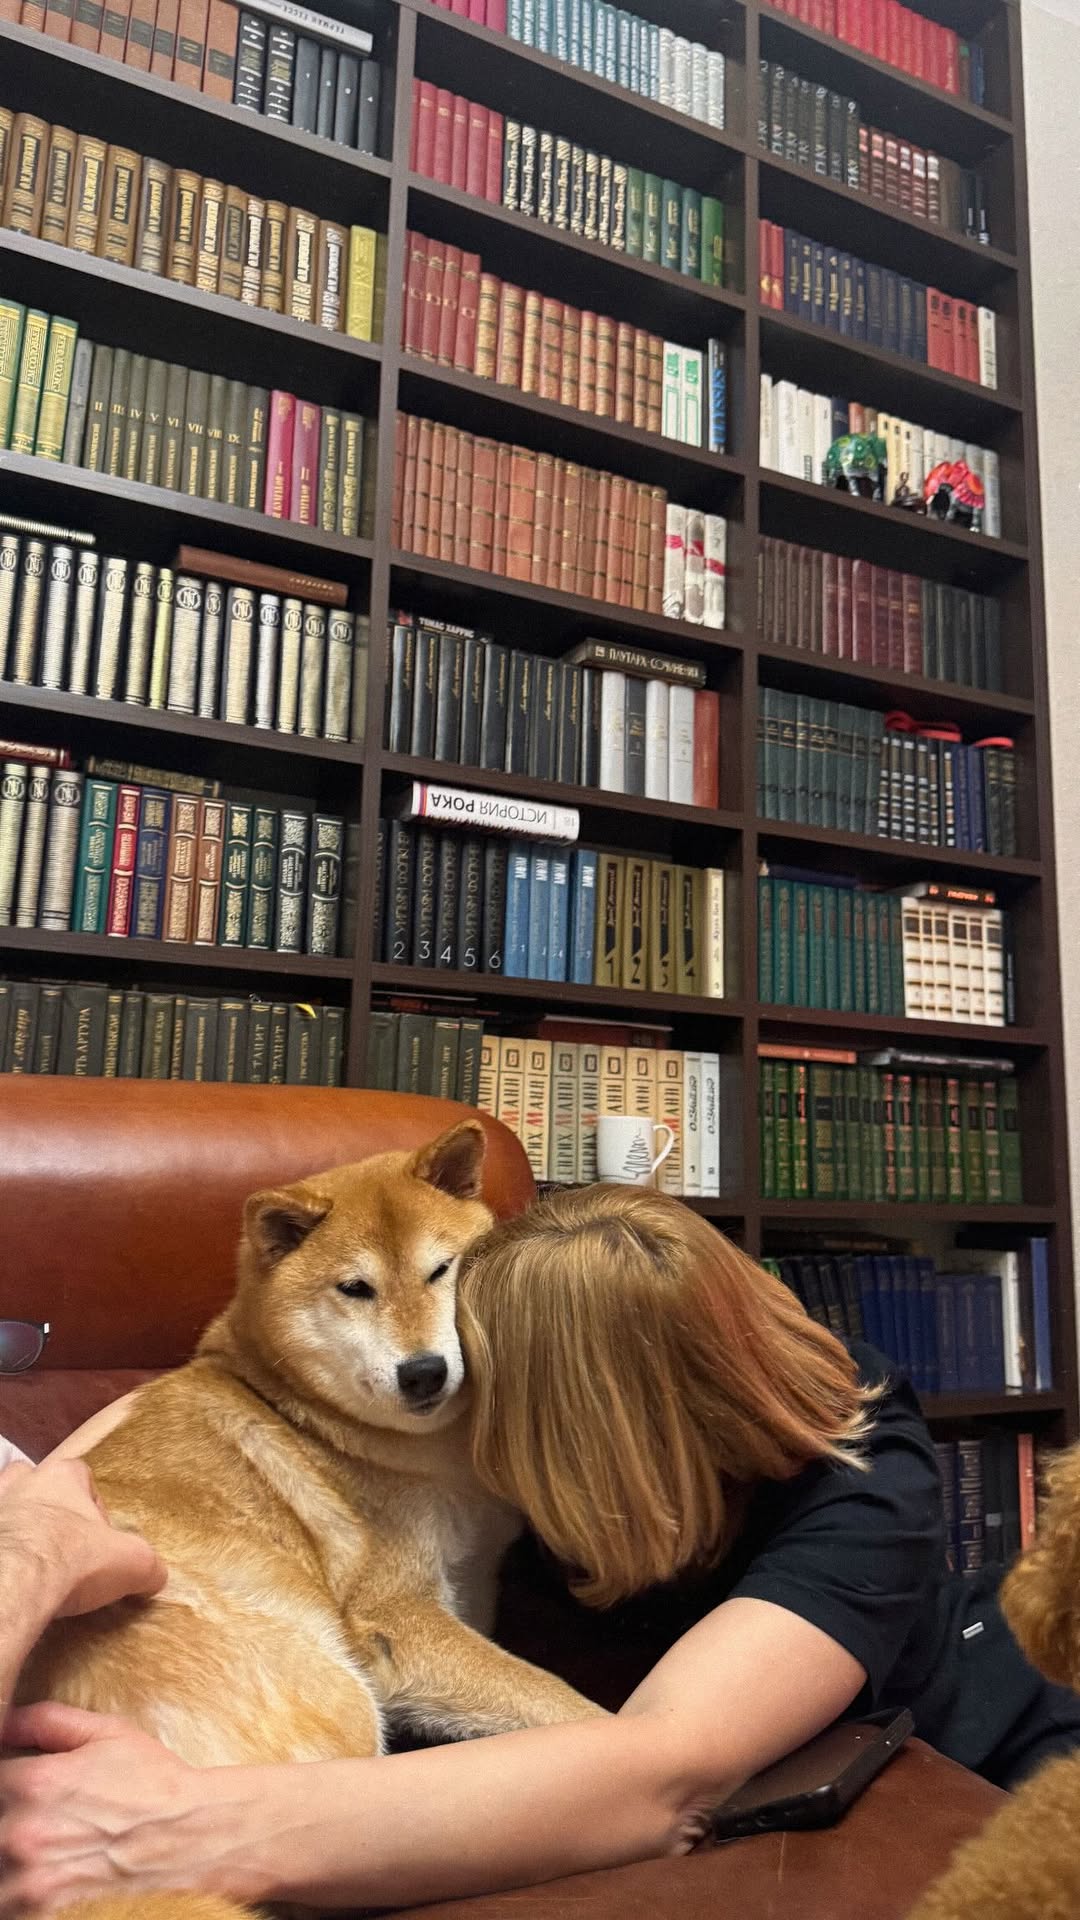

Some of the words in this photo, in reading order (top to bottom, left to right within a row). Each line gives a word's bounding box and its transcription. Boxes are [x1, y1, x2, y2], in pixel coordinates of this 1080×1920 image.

[95, 401, 103, 412] II
[130, 408, 142, 419] IV
[150, 412, 160, 422] V
[167, 417, 179, 427] VI
[187, 423, 204, 435] VII
[228, 433, 240, 444] IX
[419, 617, 446, 631] ТОМАС
[445, 623, 475, 639] ХАРРИС
[431, 793, 475, 813] РОКА
[479, 800, 547, 825] ИСТОРИЯ
[392, 941, 406, 960] 2
[418, 940, 431, 959] 3
[440, 945, 452, 963] 4
[463, 947, 476, 967] 5
[488, 950, 502, 969] 6
[605, 956, 614, 984] 1
[631, 956, 641, 984] 2
[76, 1007, 91, 1053] АРТУРА
[252, 1024, 265, 1069] ТАЦИТ
[273, 1025, 285, 1070] ТАЦИТ
[501, 1078, 520, 1126] МАНН
[526, 1080, 545, 1127] МАНН
[554, 1082, 574, 1128] МАНН
[580, 1082, 598, 1128] МАНН
[606, 1084, 623, 1113] АНН
[636, 1086, 649, 1114] АНН
[662, 1088, 681, 1134] МАНН
[526, 1132, 543, 1175] ЕНРИХ
[556, 1133, 574, 1176] ЕНРИХ
